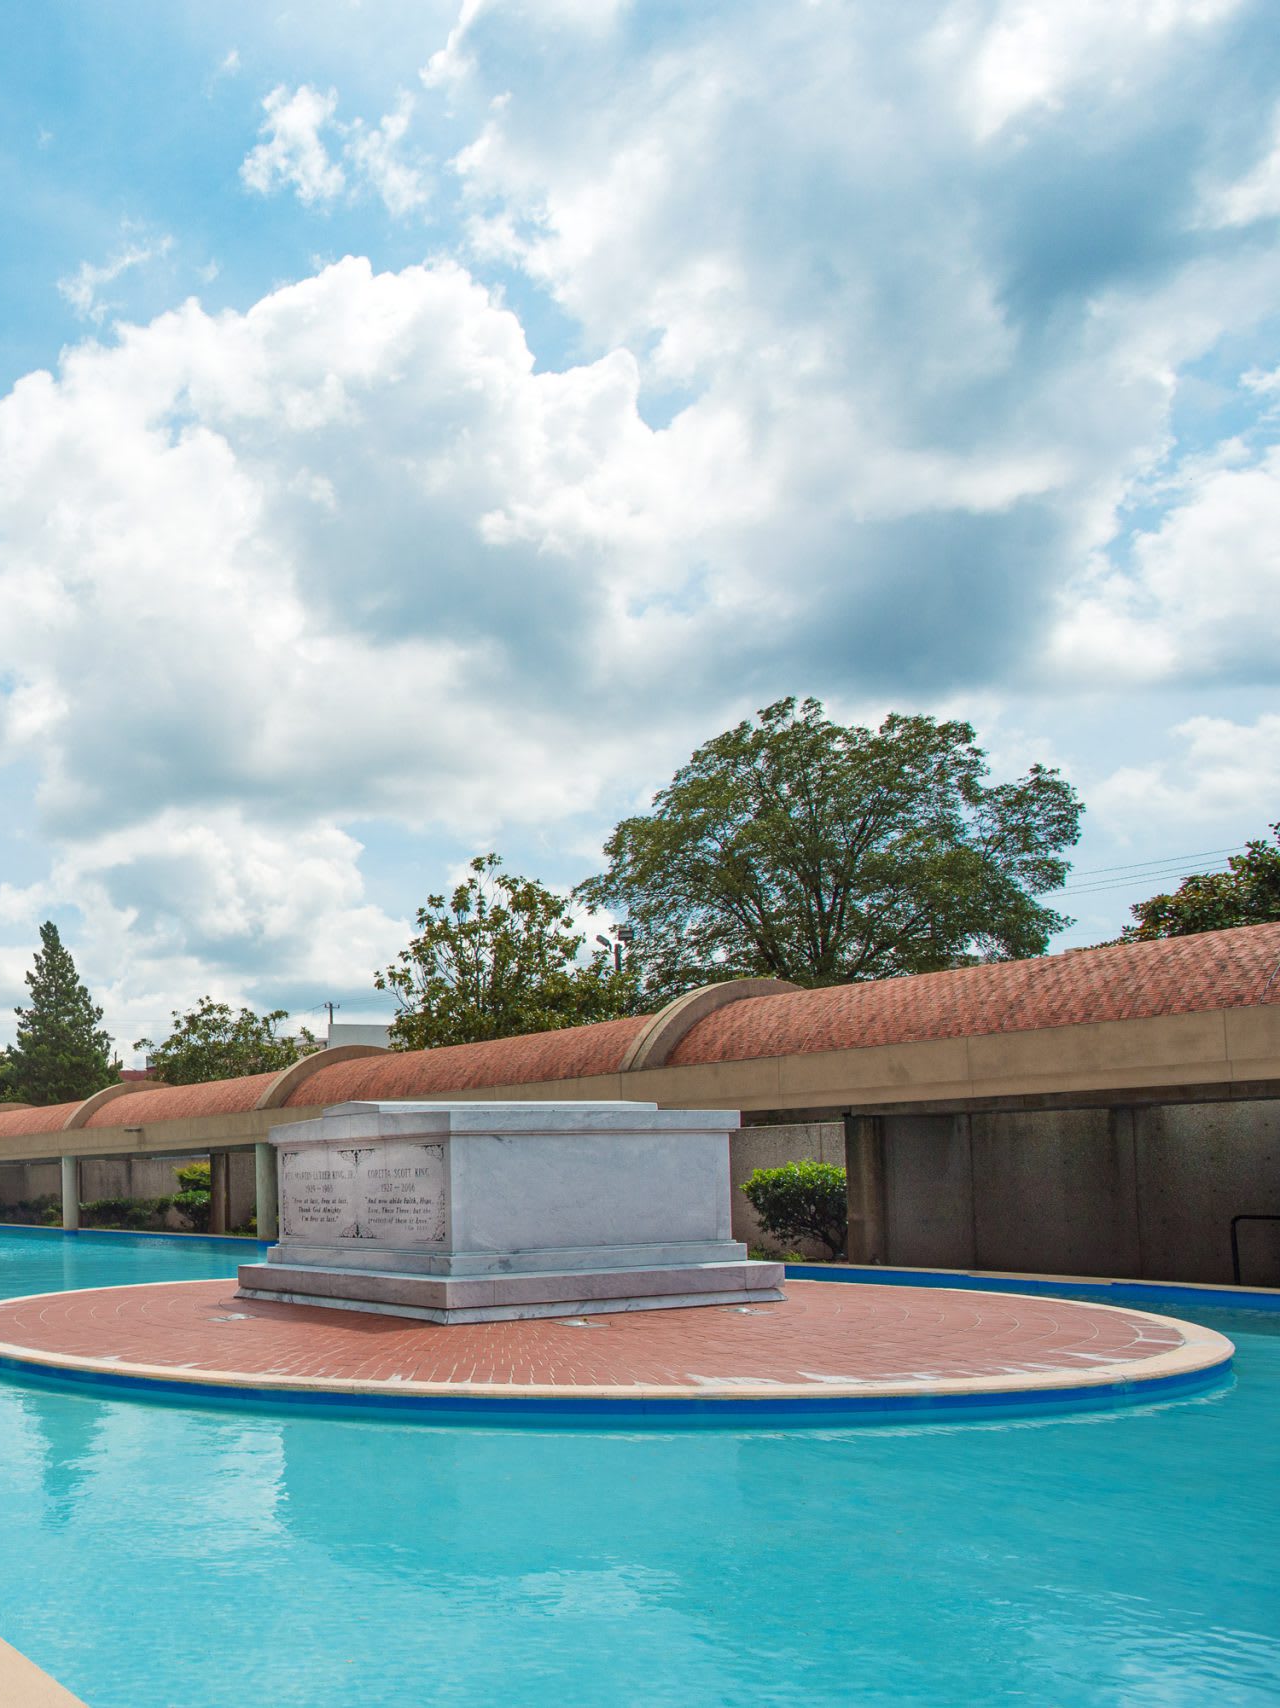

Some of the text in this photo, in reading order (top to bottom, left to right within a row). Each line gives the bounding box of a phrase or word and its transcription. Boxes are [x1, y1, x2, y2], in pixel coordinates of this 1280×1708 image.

[367, 1167, 430, 1178] CORETTA SCOTT KING
